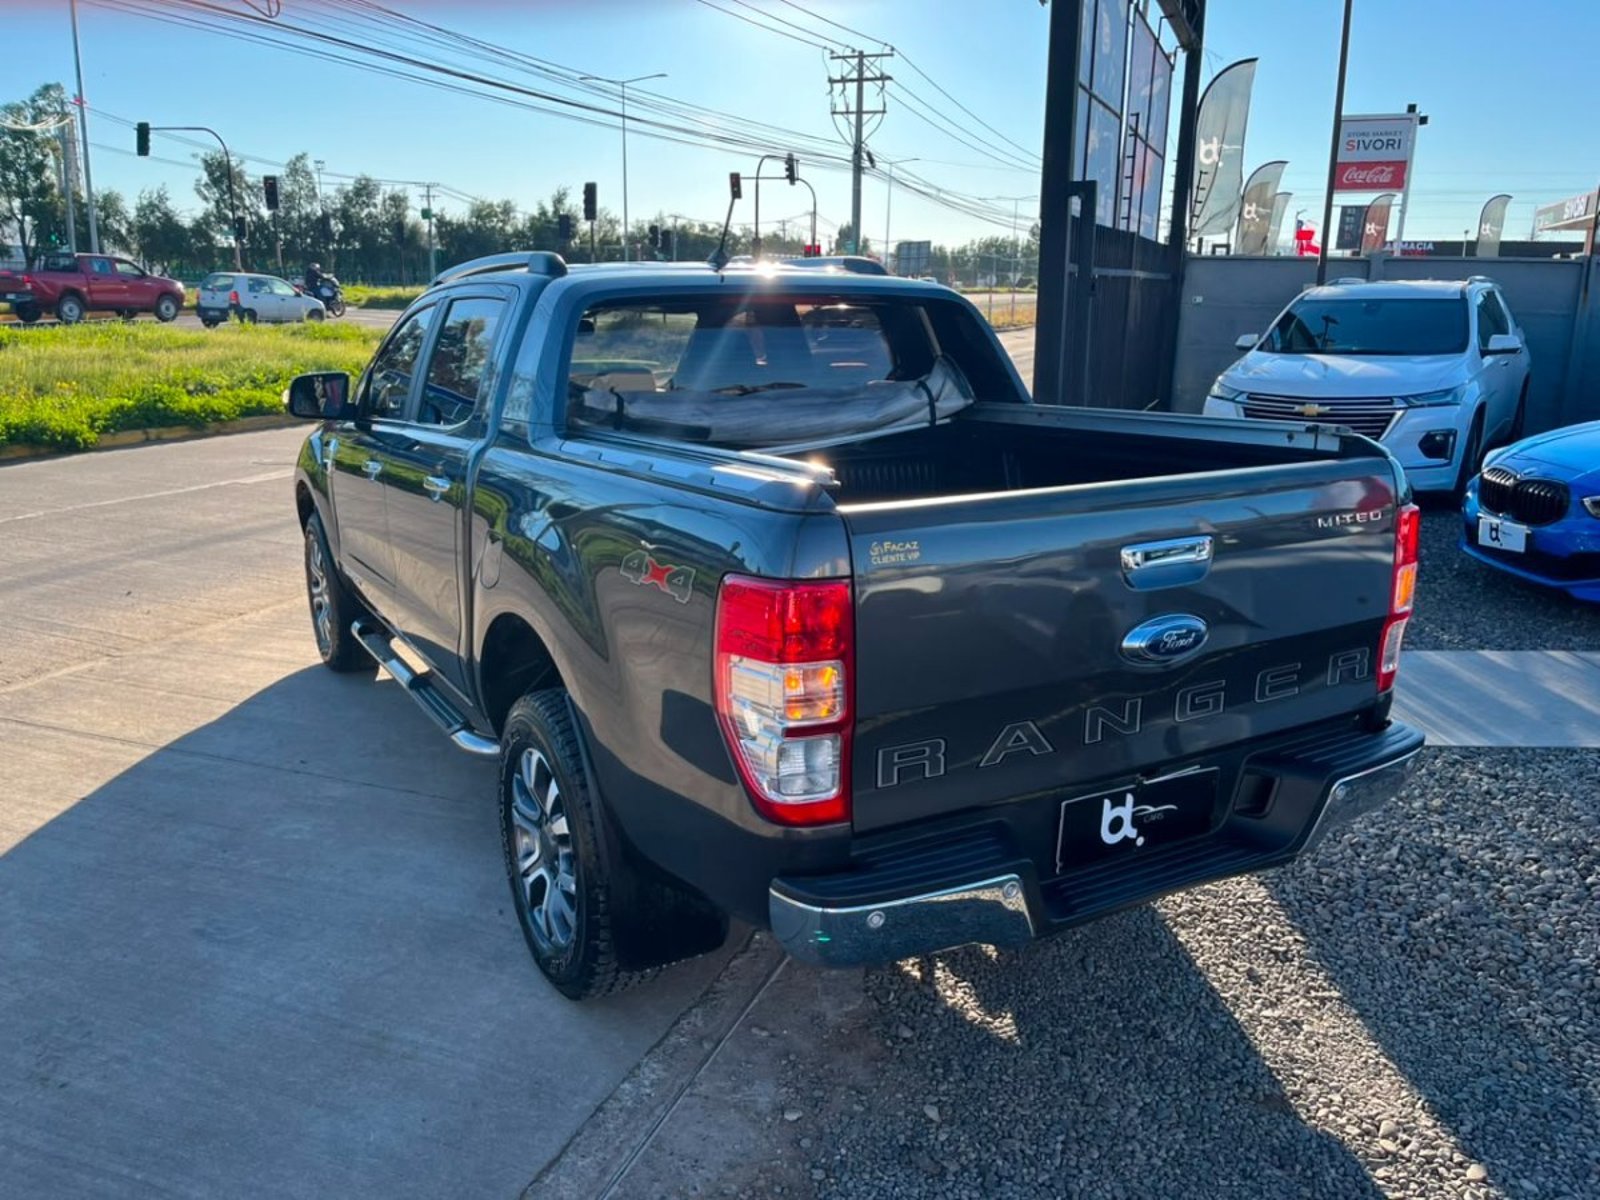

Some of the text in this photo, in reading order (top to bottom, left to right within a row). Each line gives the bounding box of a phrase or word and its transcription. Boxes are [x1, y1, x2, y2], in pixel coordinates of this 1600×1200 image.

[1345, 138, 1402, 152] SIVORI
[1160, 629, 1196, 653] Ford
[875, 646, 1371, 789] RANGER
